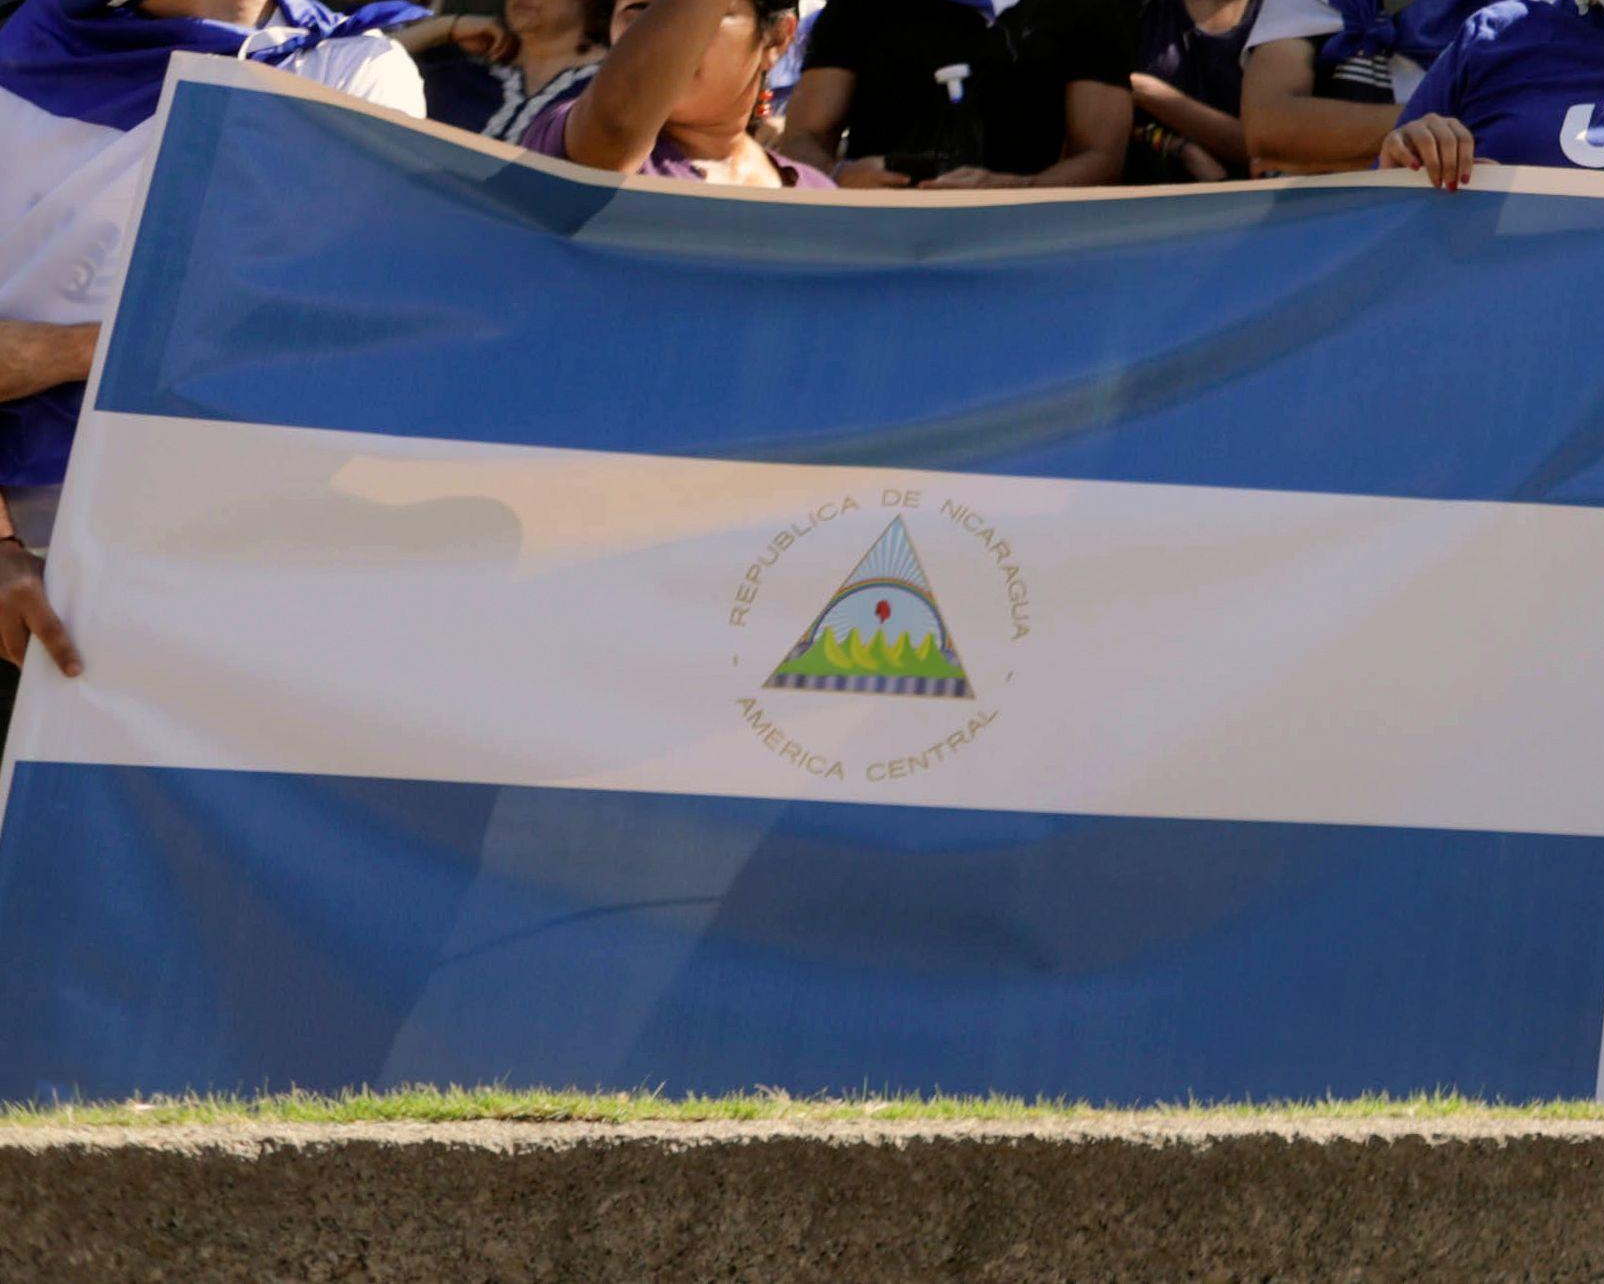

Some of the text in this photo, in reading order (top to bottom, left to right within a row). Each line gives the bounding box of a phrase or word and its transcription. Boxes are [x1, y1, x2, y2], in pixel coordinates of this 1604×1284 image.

[729, 488, 1031, 642] REPUBLICA DE NICARAGUA
[735, 694, 1001, 783] AMERICA CENTRAL
